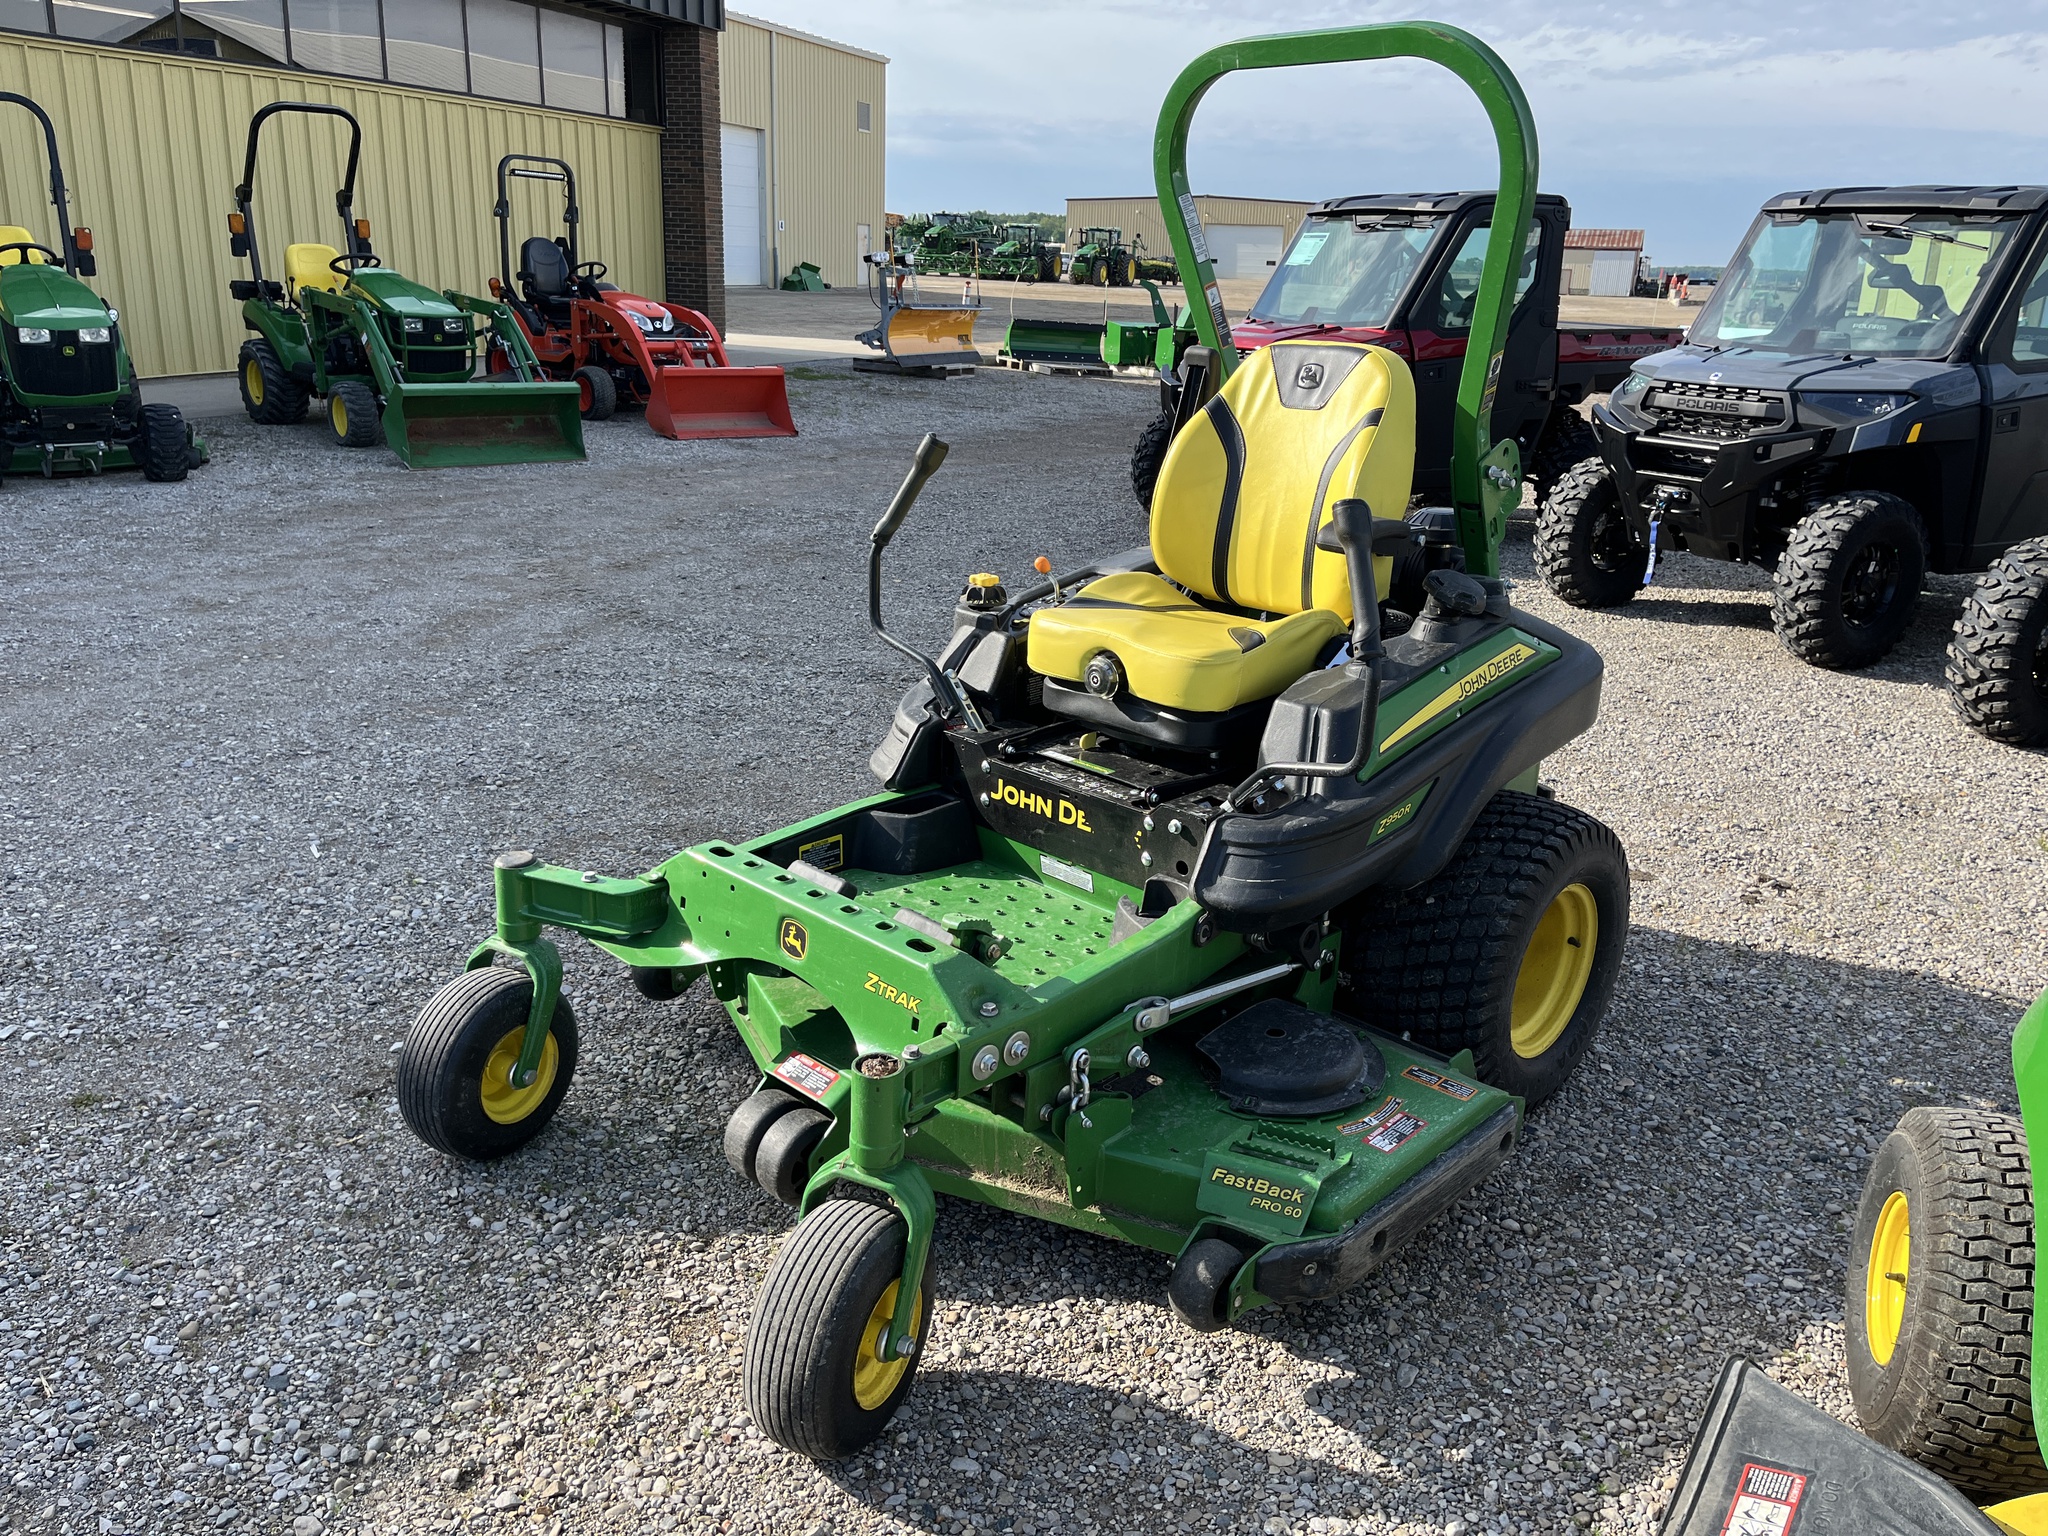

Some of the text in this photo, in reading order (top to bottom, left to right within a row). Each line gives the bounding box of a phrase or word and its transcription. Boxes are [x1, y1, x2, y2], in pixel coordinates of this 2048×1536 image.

[1599, 345, 1666, 356] RANGER
[1676, 398, 1740, 413] POLARIS
[1458, 648, 1523, 700] JOHN DEERE
[990, 778, 1052, 819] JOHN
[1376, 803, 1412, 835] Z950R
[863, 971, 922, 1014] ZTRAK
[1211, 1167, 1305, 1204] FastBack
[1250, 1196, 1302, 1218] PRO 60
